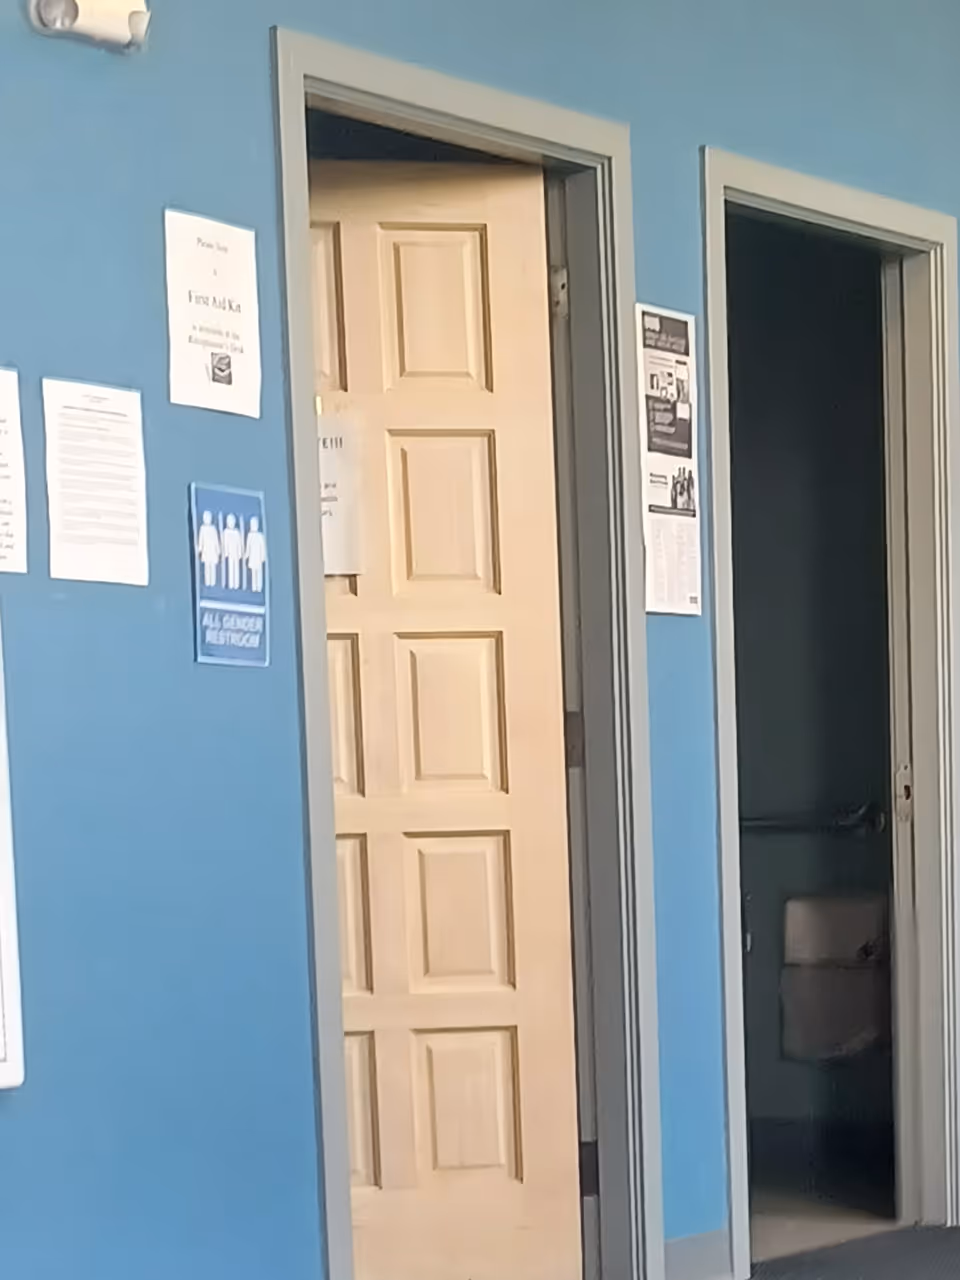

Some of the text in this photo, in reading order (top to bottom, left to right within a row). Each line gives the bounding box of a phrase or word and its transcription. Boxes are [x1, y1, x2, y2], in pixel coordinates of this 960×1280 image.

[188, 290, 242, 314] First Aid Kit
[202, 611, 264, 633] ALL GENDER
[205, 629, 260, 648] RESTROOM
